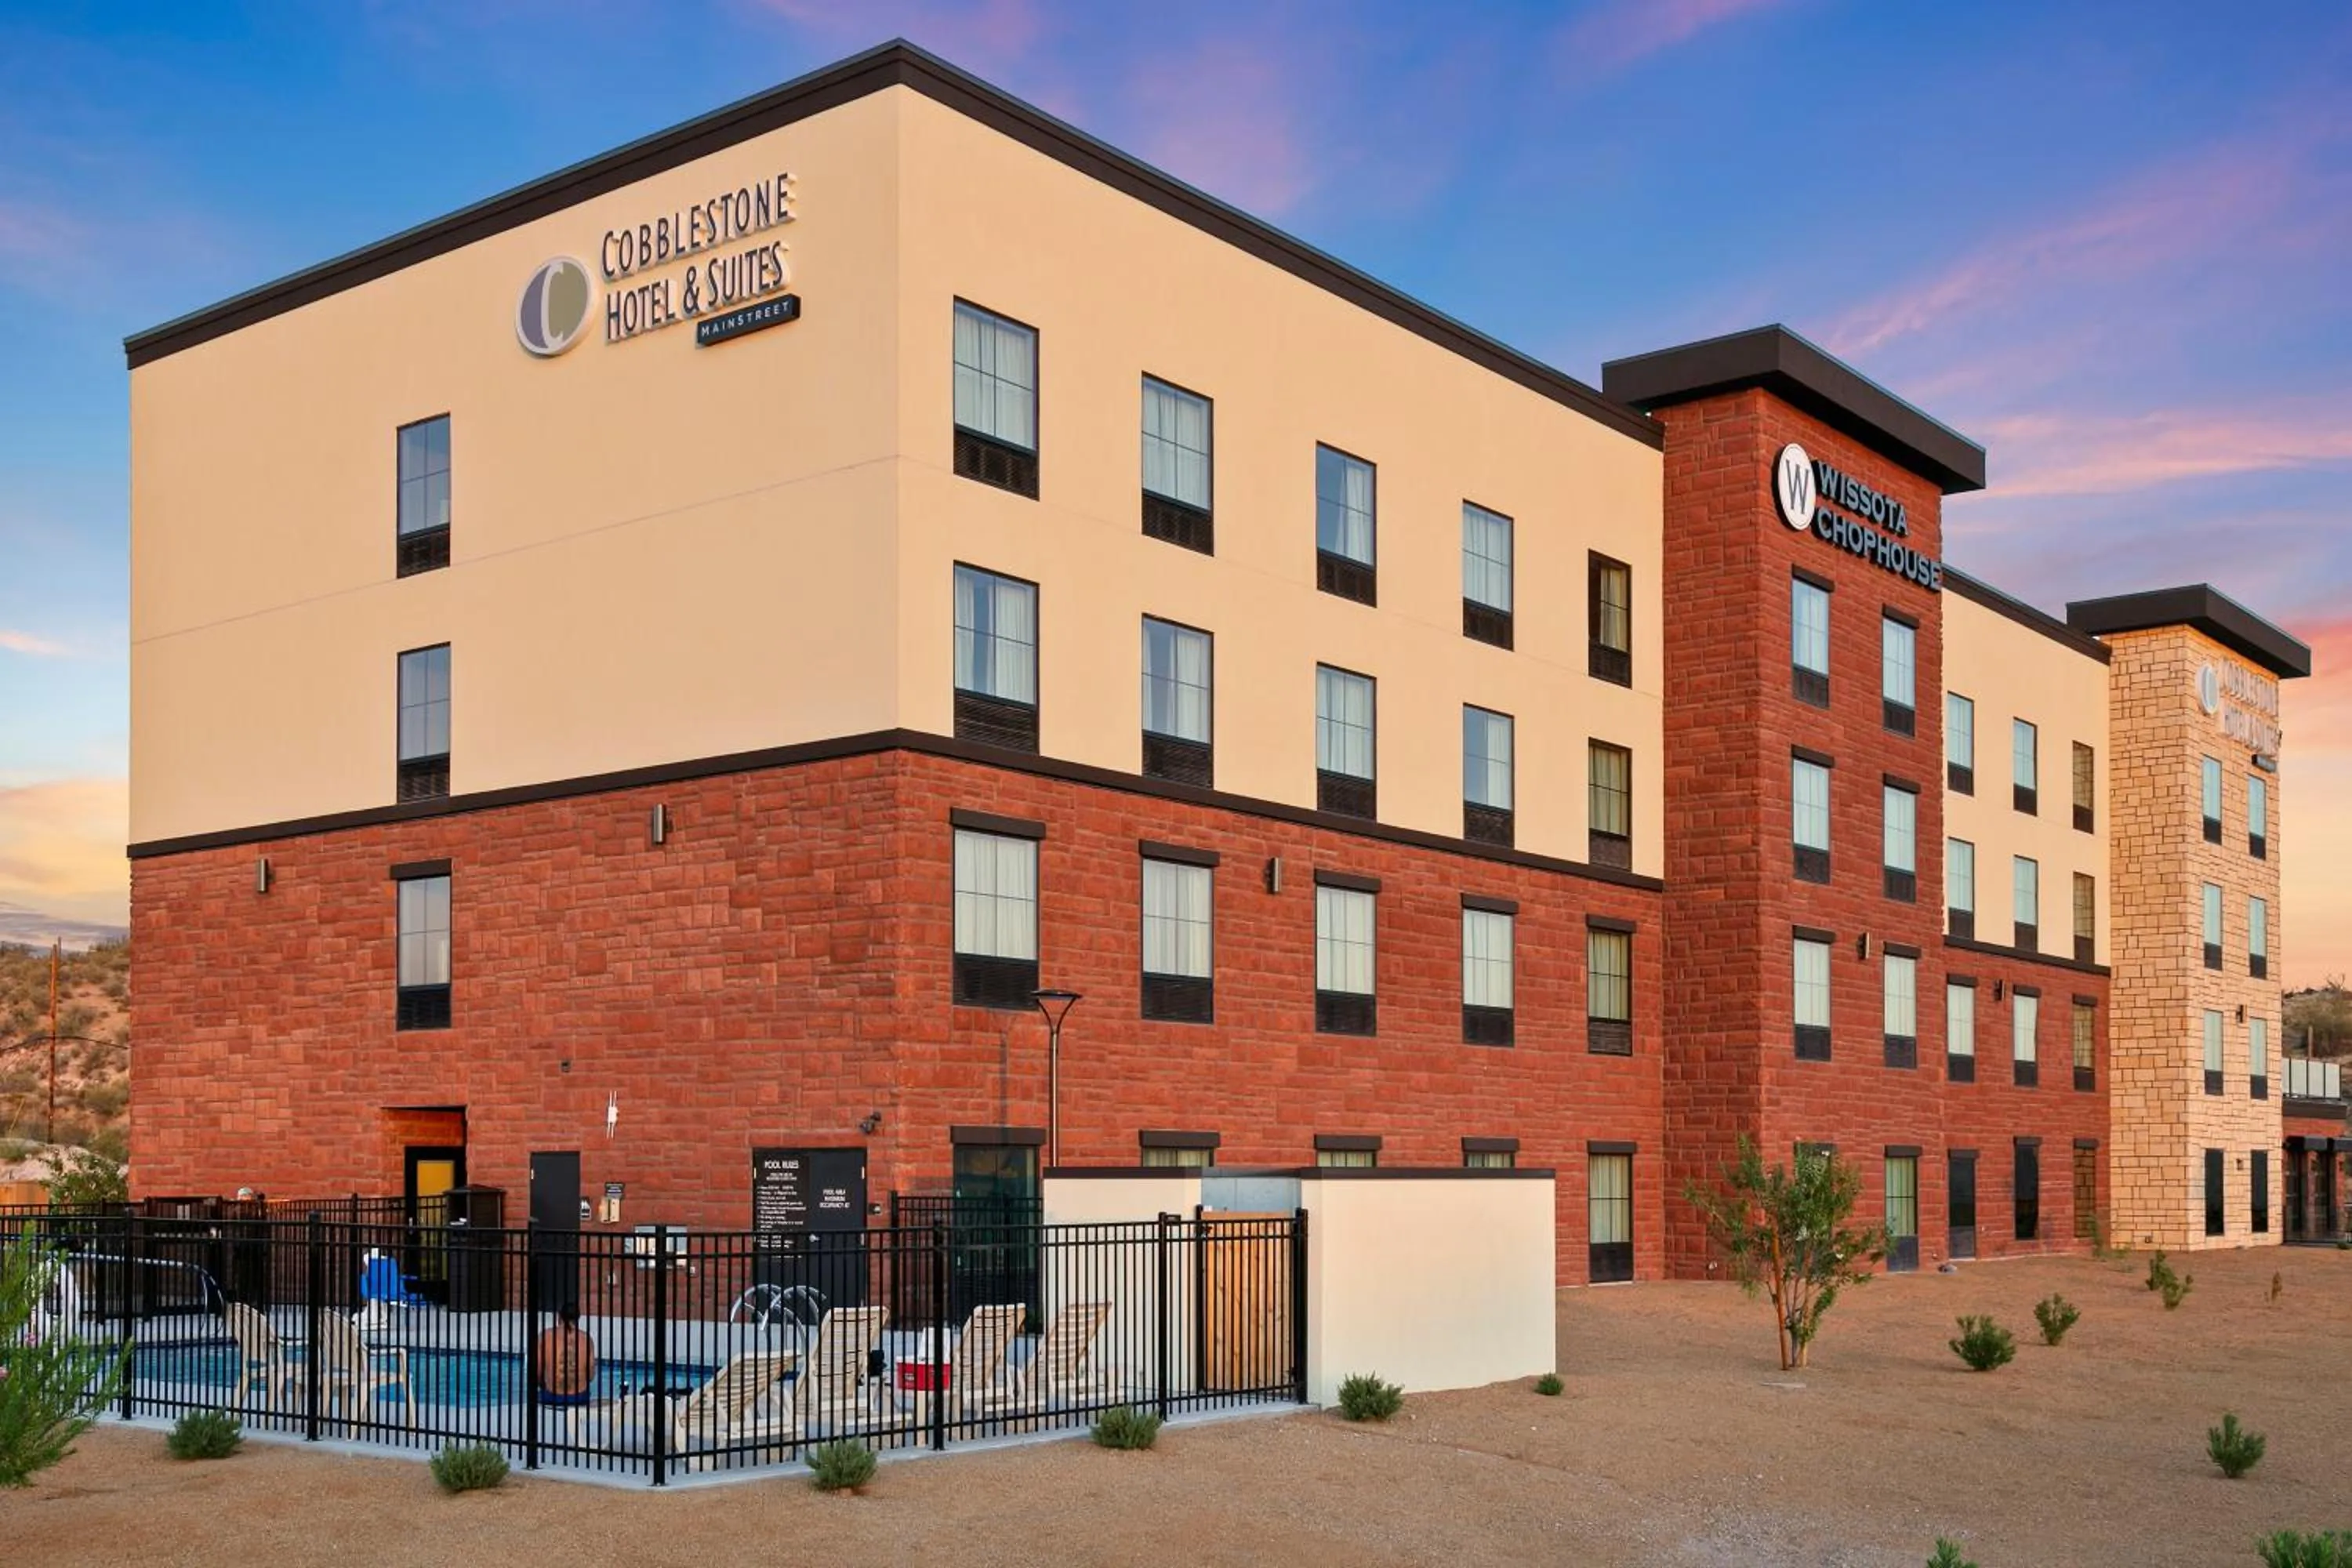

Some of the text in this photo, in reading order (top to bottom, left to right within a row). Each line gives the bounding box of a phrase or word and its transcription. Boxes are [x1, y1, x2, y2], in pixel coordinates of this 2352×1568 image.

[602, 172, 790, 278] COBBLESTONE
[605, 240, 784, 339] HOTEL & SUITES
[700, 300, 790, 338] MAINSTREET
[1785, 459, 1810, 515] W
[1817, 459, 1910, 536] WISSOTA
[1816, 506, 1942, 590] CHOPHOUSE
[764, 1160, 782, 1170] POOL
